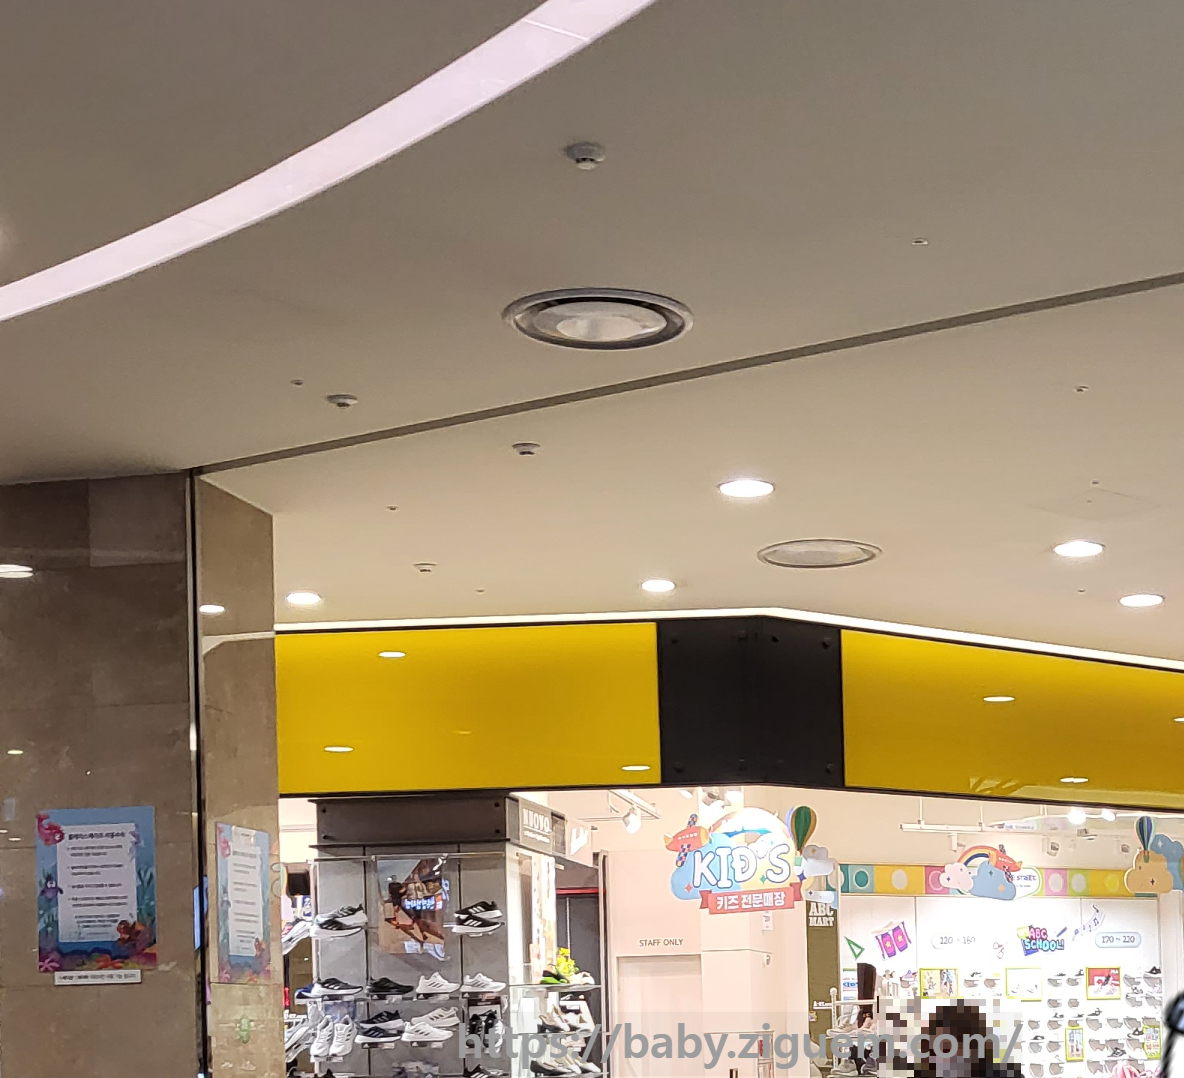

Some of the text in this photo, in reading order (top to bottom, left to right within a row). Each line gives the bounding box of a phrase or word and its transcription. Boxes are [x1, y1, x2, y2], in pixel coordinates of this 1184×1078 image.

[716, 891, 786, 911] 키즈 전문매장
[808, 902, 834, 917] ABC
[808, 916, 835, 927] MART
[1028, 926, 1048, 939] ABC
[639, 938, 684, 947] STAFF ONLY
